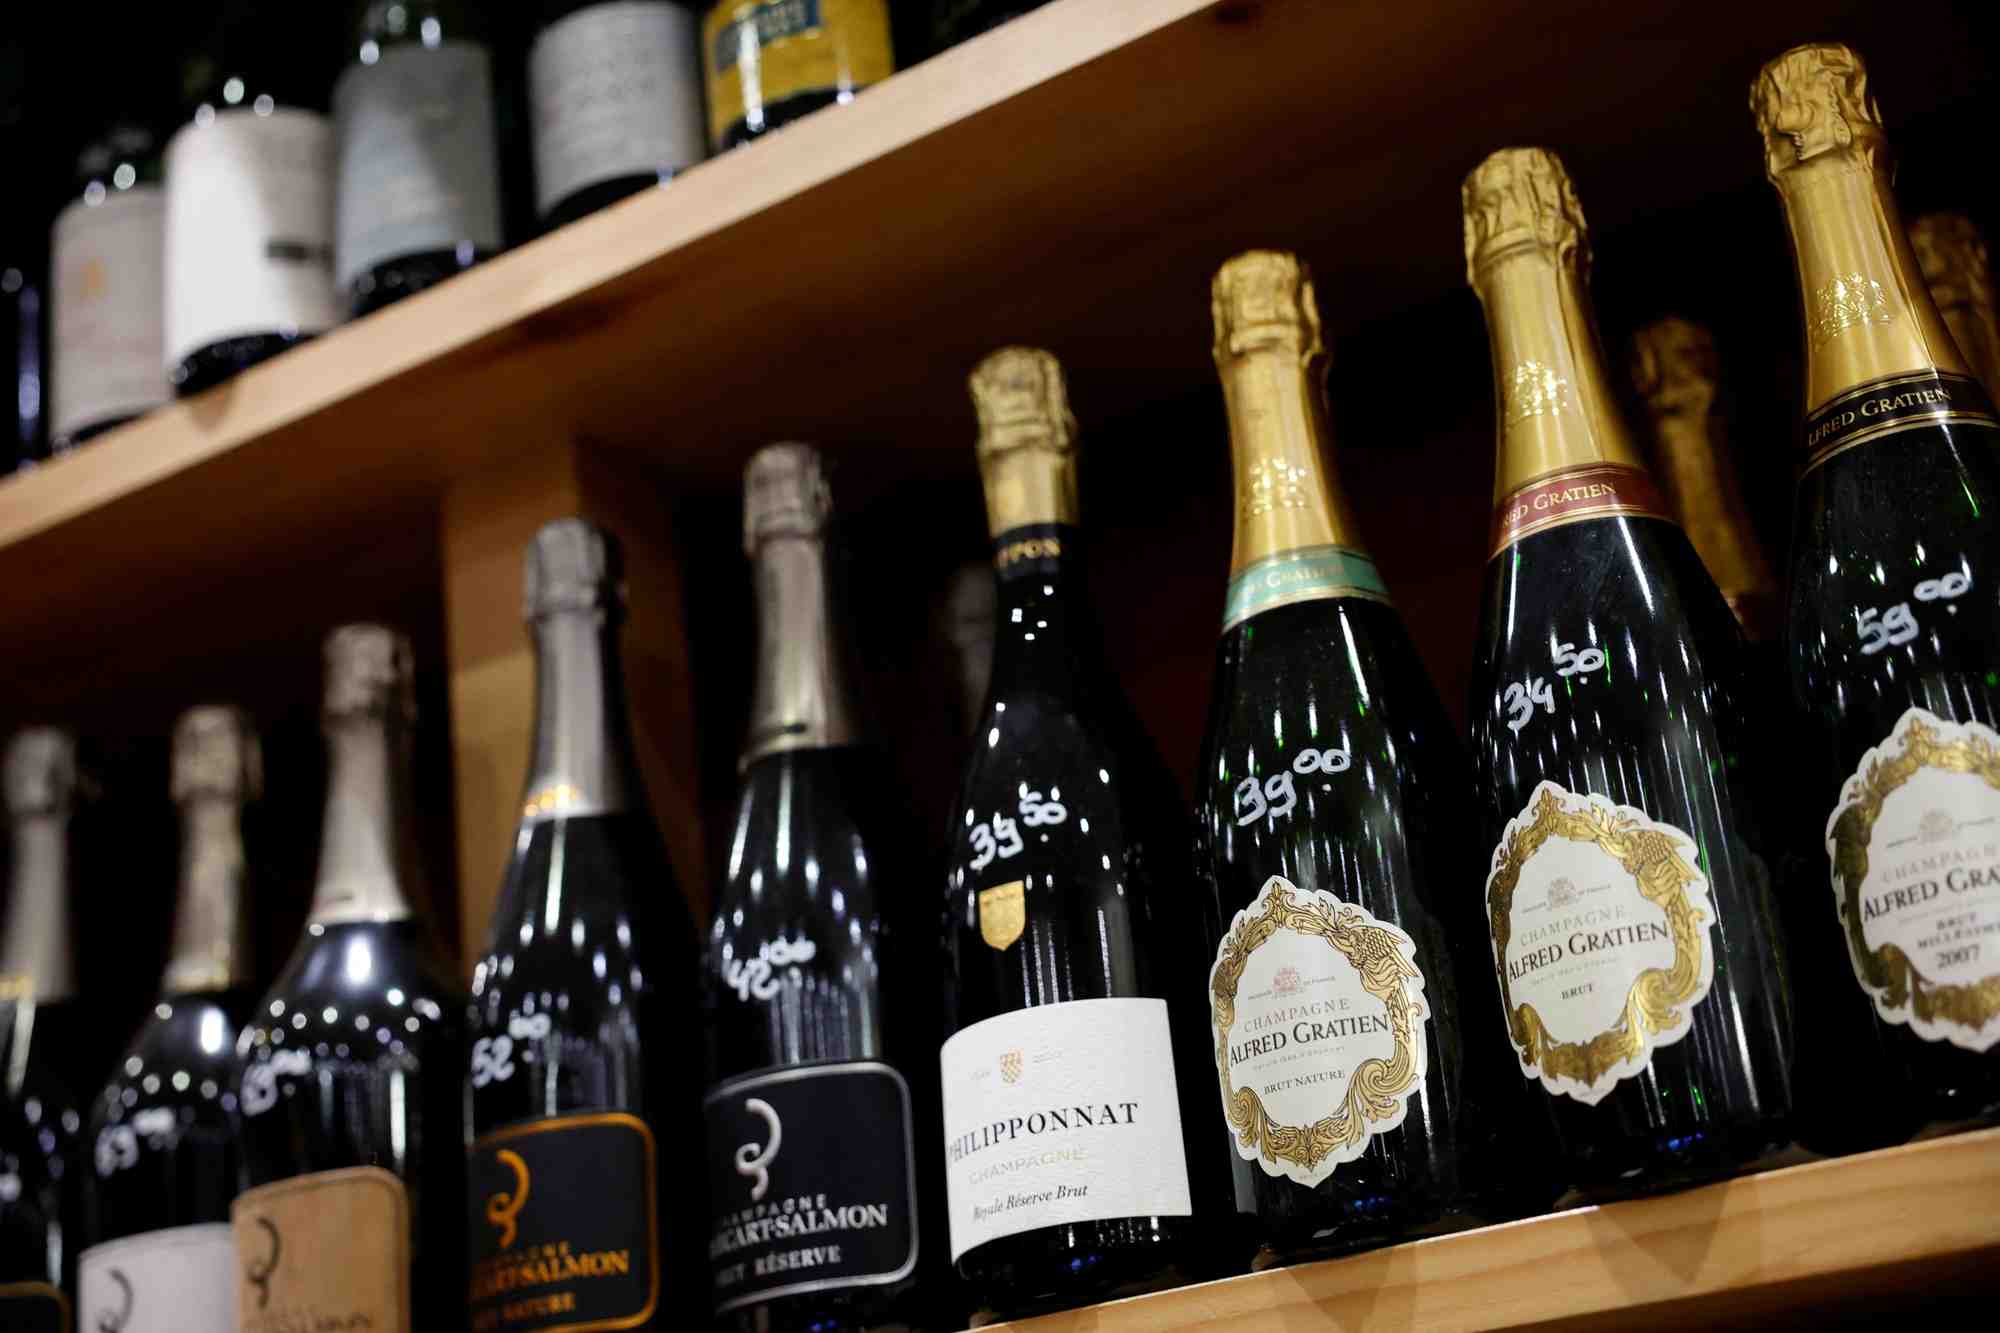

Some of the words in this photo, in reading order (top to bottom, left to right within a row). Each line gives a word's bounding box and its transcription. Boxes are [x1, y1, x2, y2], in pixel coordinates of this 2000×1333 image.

[1861, 387, 1951, 417] GRATIEN
[1534, 482, 1617, 511] GRATIEN
[1863, 880, 1940, 922] ALFRED
[1946, 862, 2000, 894] GRA
[1519, 903, 1626, 946] CHAMPAGNE
[1508, 943, 1563, 983] ALFRED
[1567, 919, 1670, 956] GRATIEN
[1560, 982, 1594, 1001] BRUT
[1243, 997, 1351, 1033] CHAMPAGNE
[1230, 1030, 1287, 1068] ALFRED
[1292, 1012, 1390, 1045] GRATIEN
[1263, 1079, 1293, 1096] BRUT
[1295, 1069, 1347, 1087] NATURE
[968, 1147, 1088, 1186] CHAMPAGNE
[1006, 1190, 1053, 1211] Réserve
[1056, 1183, 1089, 1201] Brut
[754, 1245, 841, 1276] RÉSERVE
